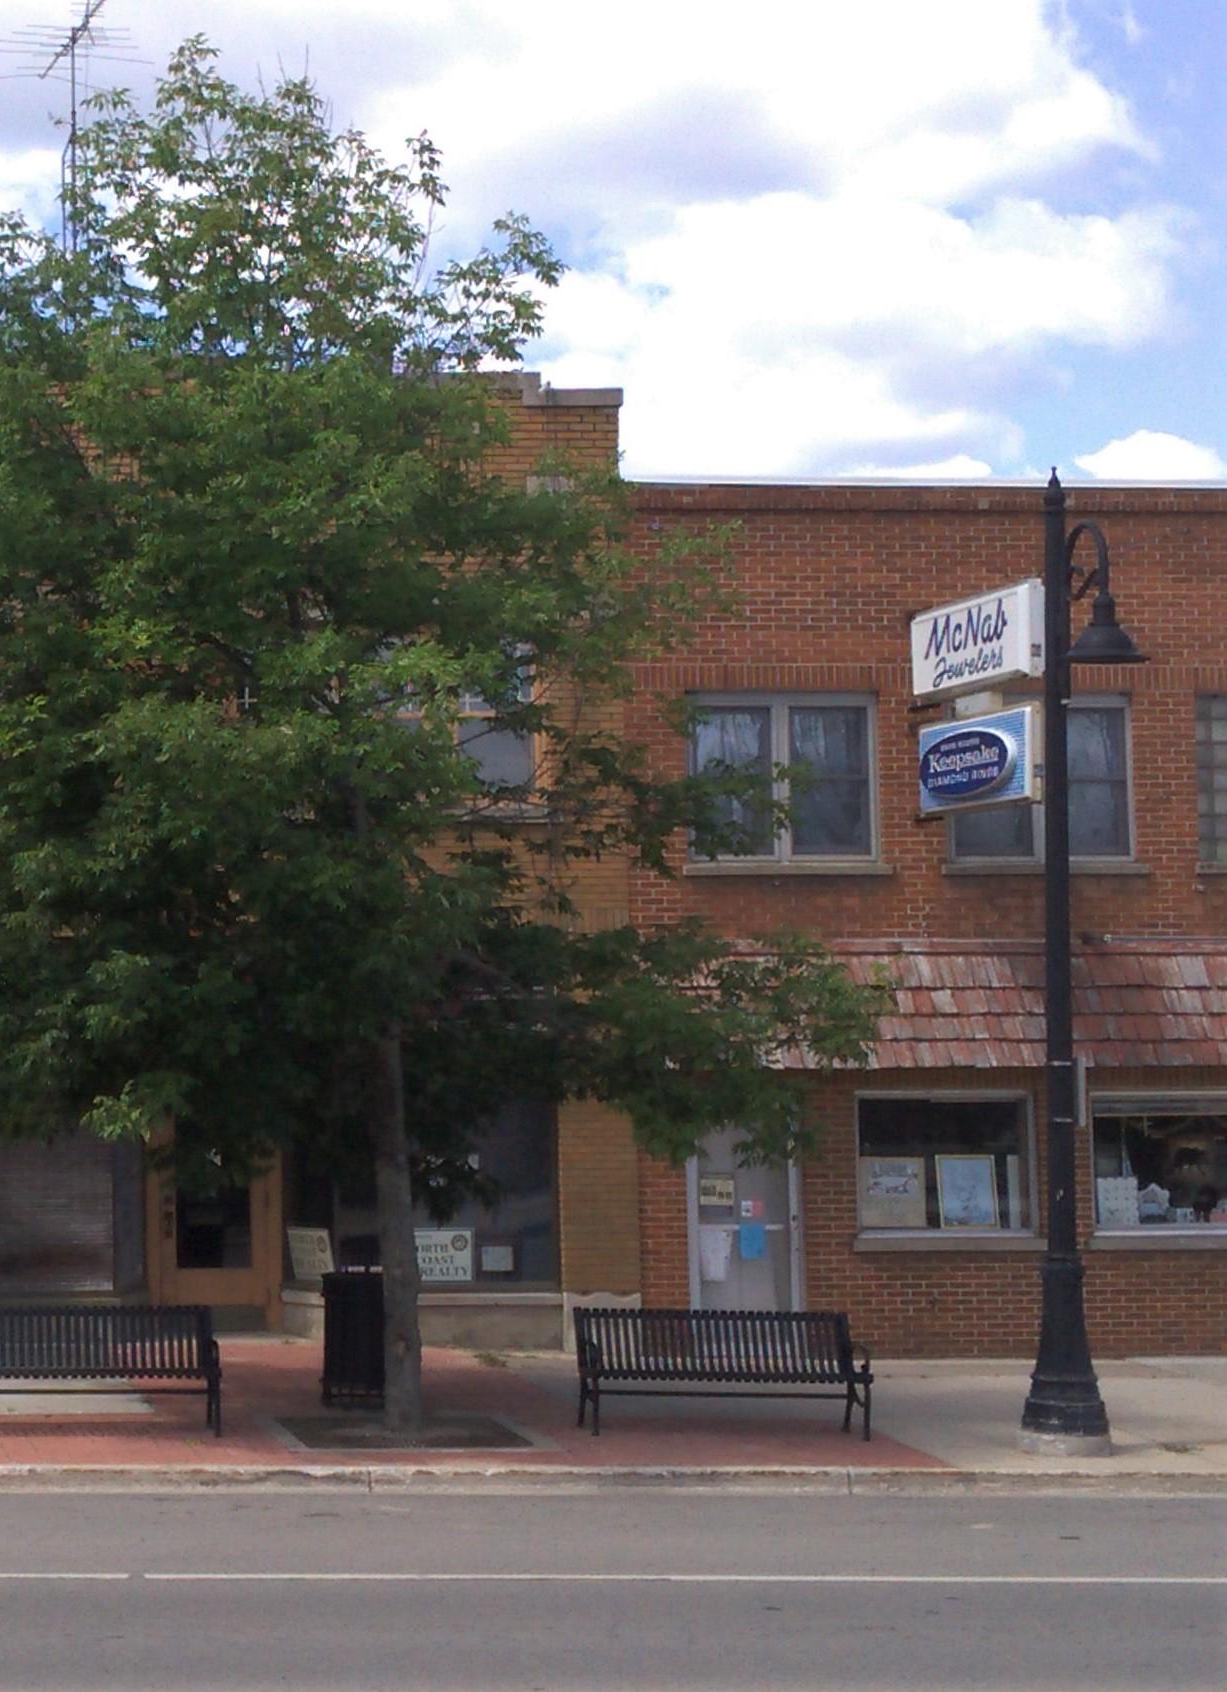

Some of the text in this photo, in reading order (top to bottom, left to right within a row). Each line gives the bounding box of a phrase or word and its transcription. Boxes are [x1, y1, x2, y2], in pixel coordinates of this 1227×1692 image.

[924, 598, 1007, 660] McNab
[933, 647, 1003, 688] Jewelers
[928, 744, 999, 773] Keepsake
